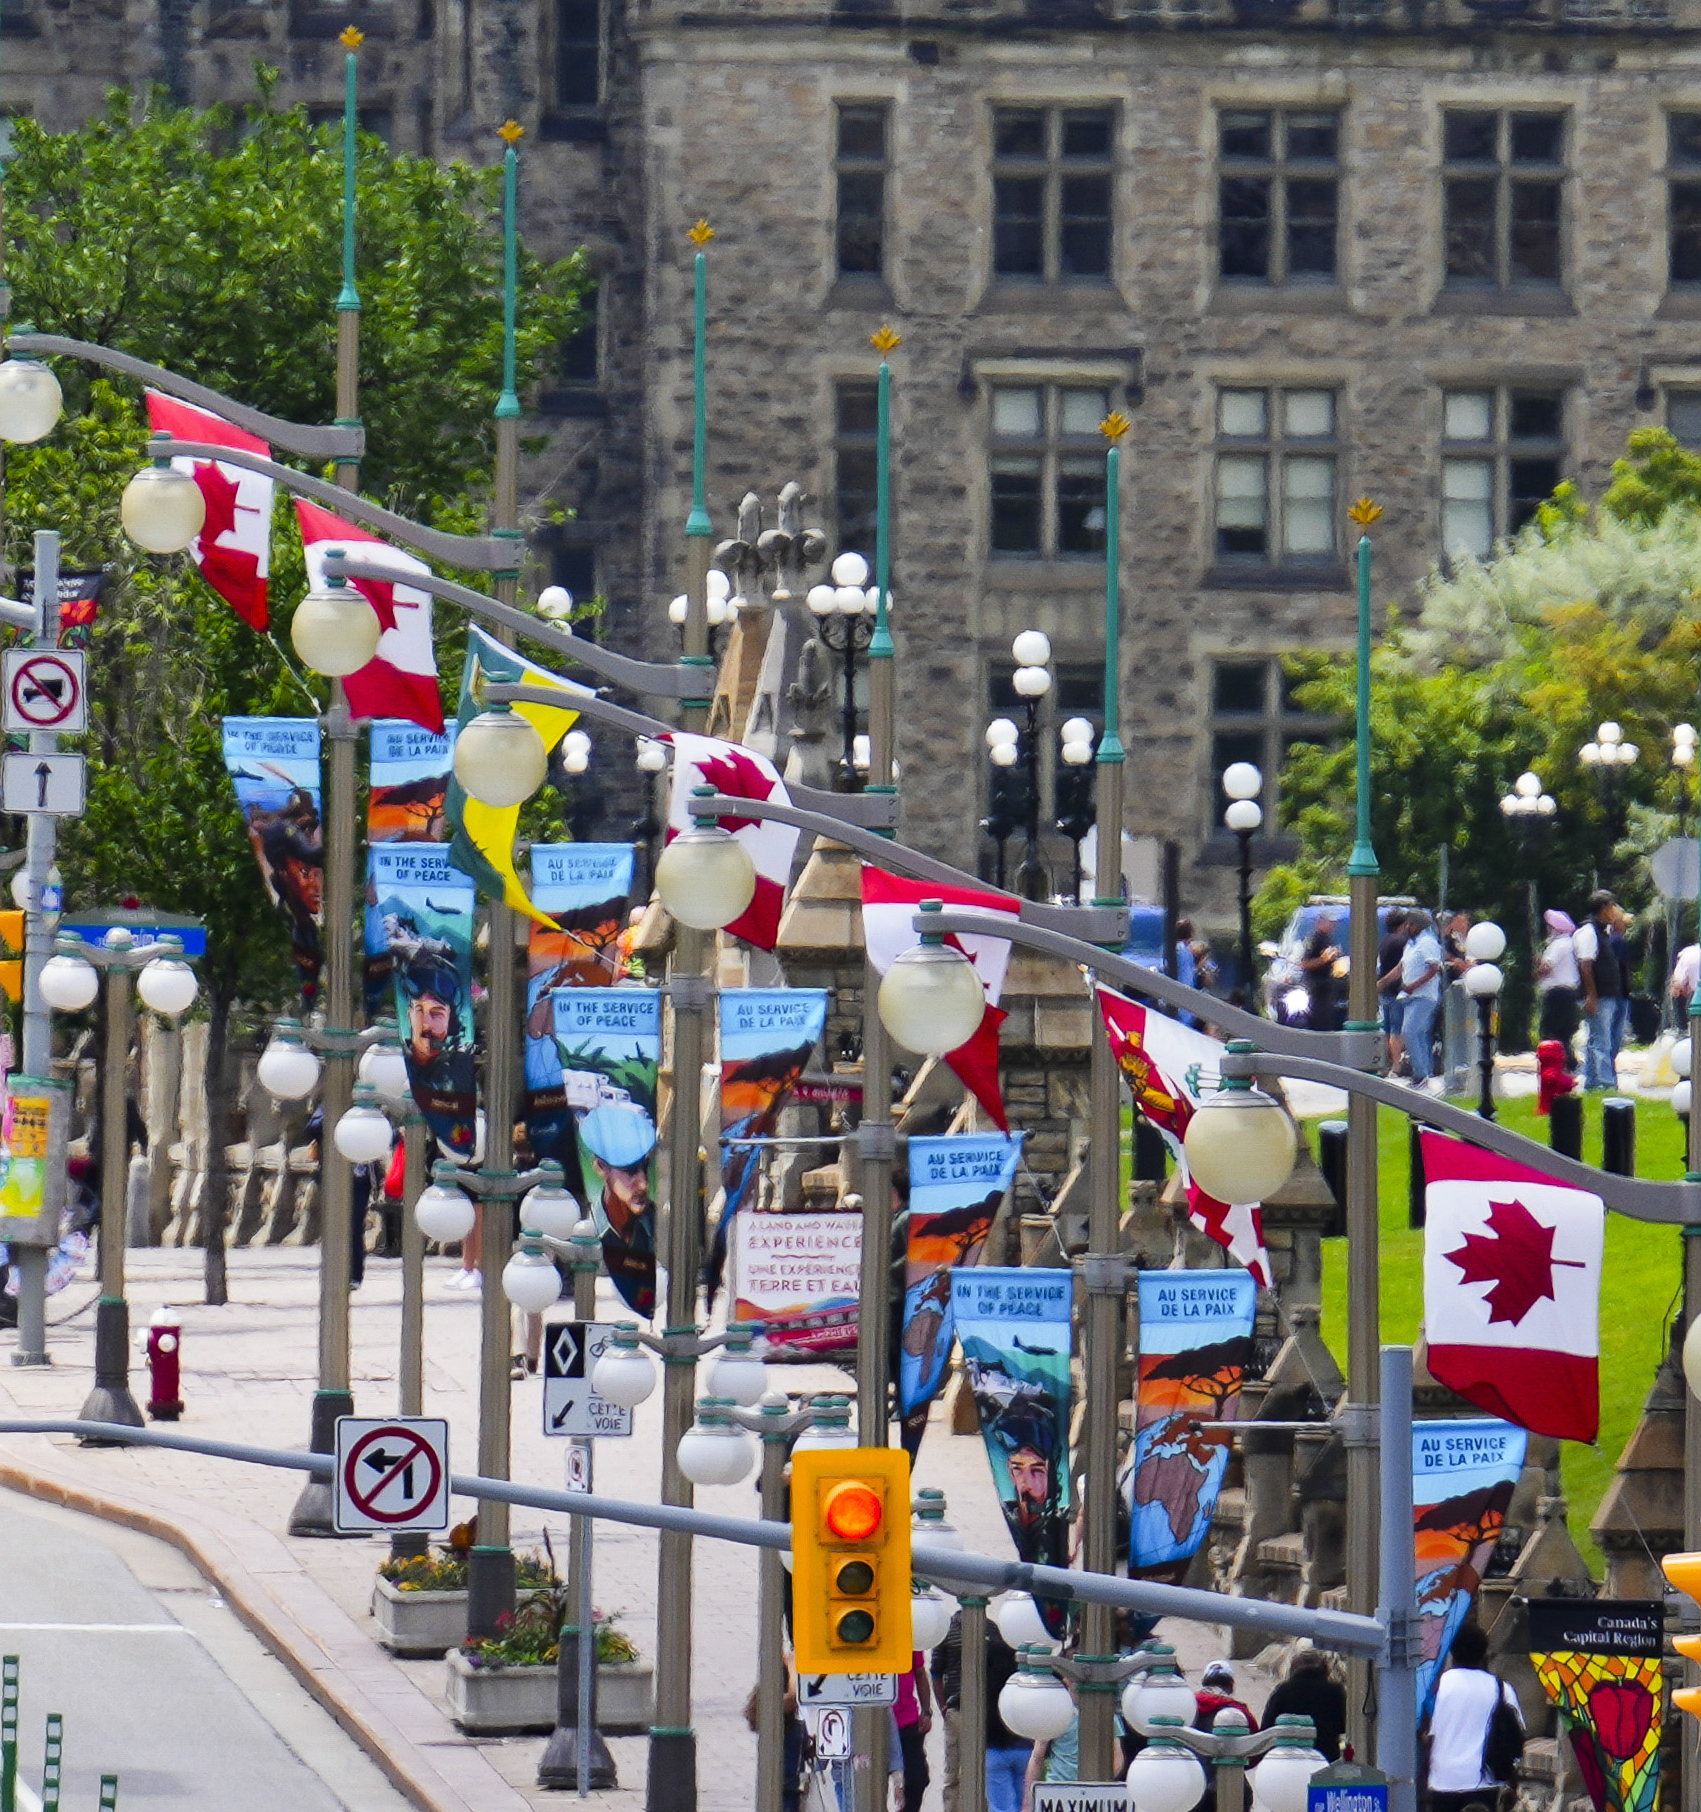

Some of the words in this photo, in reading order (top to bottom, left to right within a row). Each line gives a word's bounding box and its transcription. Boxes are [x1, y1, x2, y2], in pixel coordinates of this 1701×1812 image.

[409, 745, 422, 756] LA
[379, 856, 391, 867] IN
[395, 857, 416, 868] THE
[421, 858, 449, 869] SERV
[548, 858, 562, 869] AU
[396, 869, 409, 881] OF
[414, 870, 451, 882] PEACE
[551, 870, 564, 881] DE
[559, 1001, 571, 1013] IN
[576, 1001, 598, 1013] THE
[603, 1001, 654, 1014] SERVICE
[737, 1004, 753, 1016] AU
[758, 1002, 811, 1015] SERVICE
[576, 1015, 593, 1026] OF
[596, 1015, 636, 1027] PEACE
[740, 1018, 755, 1028] DE
[760, 1017, 775, 1028] LA
[928, 1153, 945, 1165] AU
[949, 1150, 1004, 1164] SERVICE
[930, 1167, 947, 1179] DE
[951, 1165, 967, 1178] LA
[749, 1235, 863, 1250] EXPERIENCE
[749, 1278, 801, 1292] TERRE
[807, 1278, 825, 1292] ET
[957, 1284, 971, 1297] IN
[1007, 1285, 1065, 1300] SERVICE
[1158, 1288, 1176, 1301] AU
[1181, 1287, 1237, 1301] SERVICE
[978, 1301, 995, 1314] OF
[1161, 1303, 1178, 1316] DE
[1183, 1302, 1200, 1316] LA
[1205, 1302, 1235, 1316] PAIX
[595, 1417, 622, 1430] VOIE
[1421, 1437, 1441, 1451] AU
[1445, 1436, 1506, 1450] SERVICE
[1425, 1454, 1444, 1467] DE
[1449, 1453, 1467, 1466] LA
[1471, 1451, 1504, 1464] PAIX
[1597, 1616, 1658, 1630] Canada's
[1563, 1630, 1610, 1646] Capital
[1613, 1630, 1657, 1647] Region
[853, 1683, 883, 1697] VOIE
